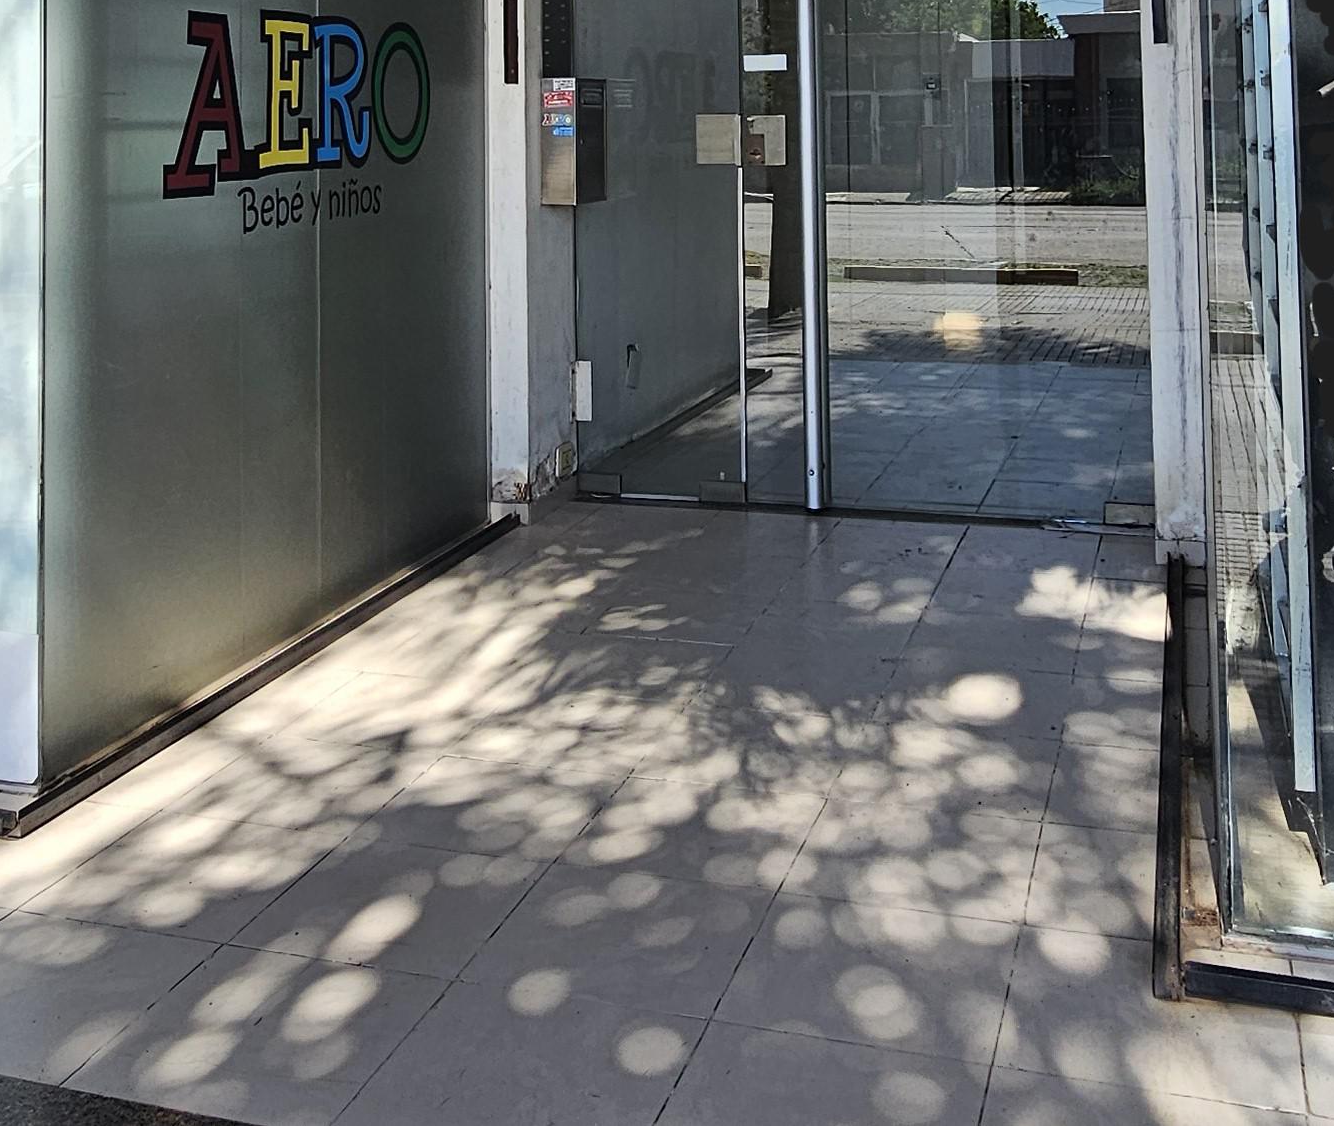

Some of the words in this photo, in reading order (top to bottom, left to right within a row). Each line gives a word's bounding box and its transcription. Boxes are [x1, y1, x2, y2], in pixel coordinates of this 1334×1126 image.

[163, 9, 430, 200] AERO
[237, 181, 303, 235] Bebé
[310, 189, 322, 226] y
[330, 178, 382, 220] niños
